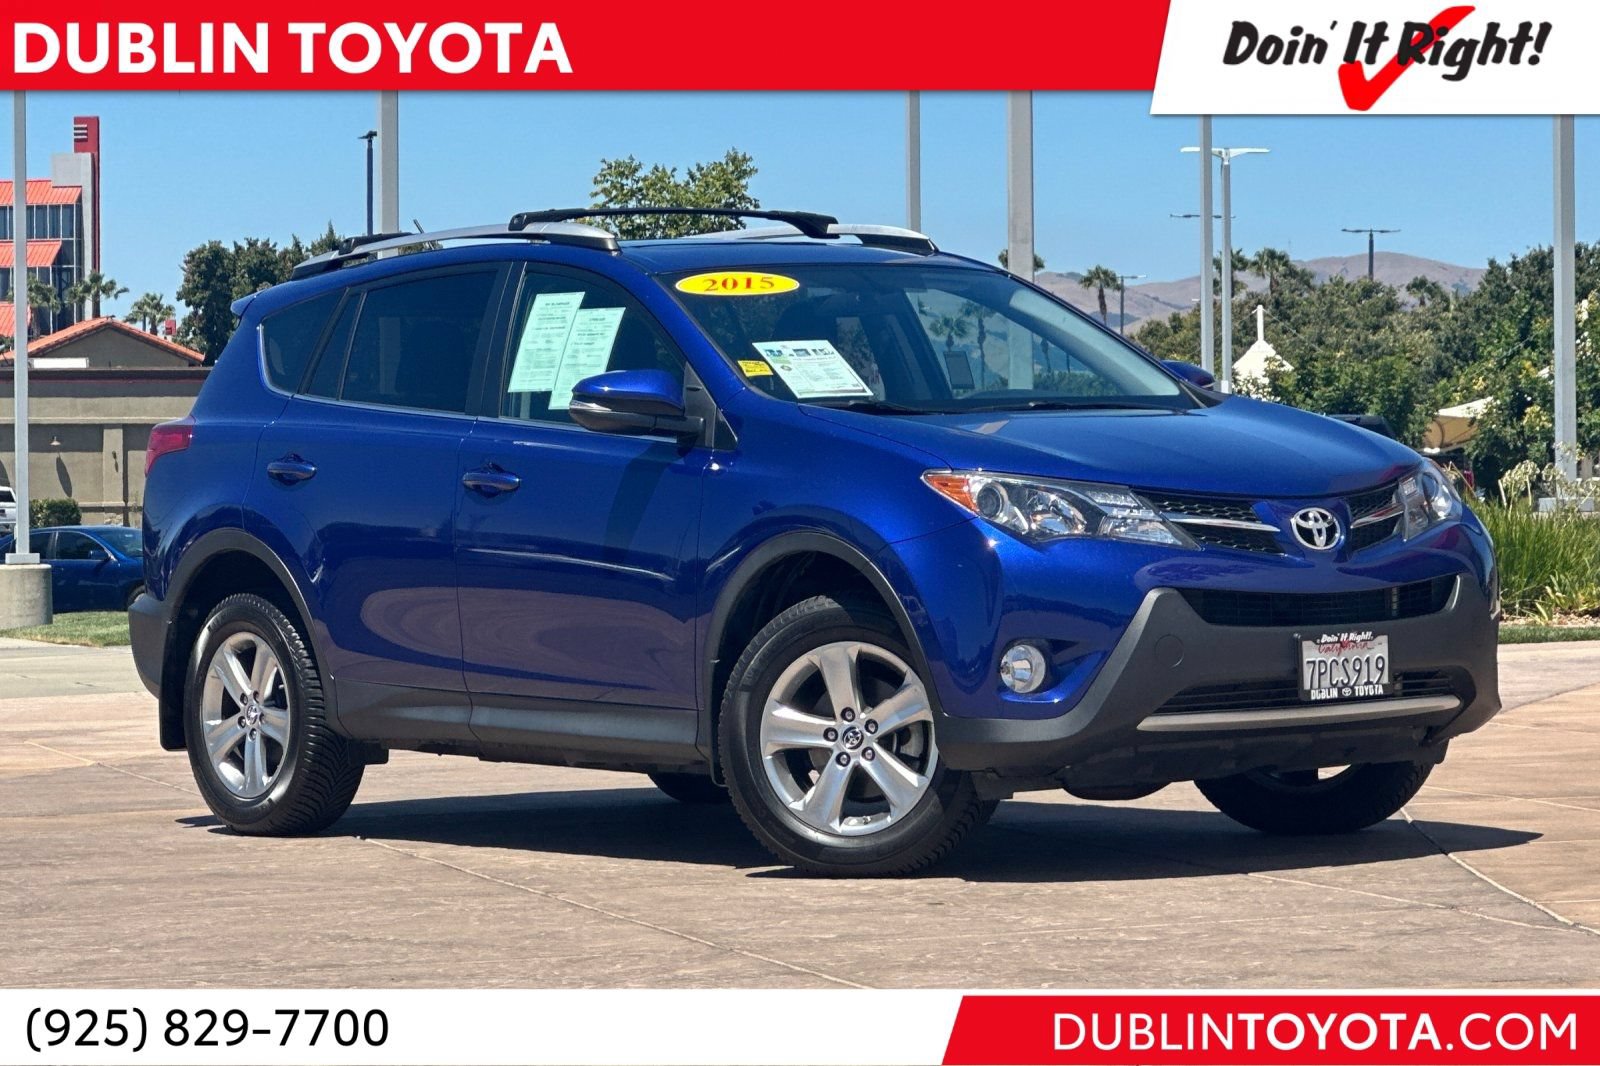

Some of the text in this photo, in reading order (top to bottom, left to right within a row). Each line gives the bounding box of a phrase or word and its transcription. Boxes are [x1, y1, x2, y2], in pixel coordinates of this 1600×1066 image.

[703, 276, 775, 292] 2015
[1305, 655, 1385, 690] 7PCS919
[1310, 684, 1384, 700] DUBLIN TOYOTA
